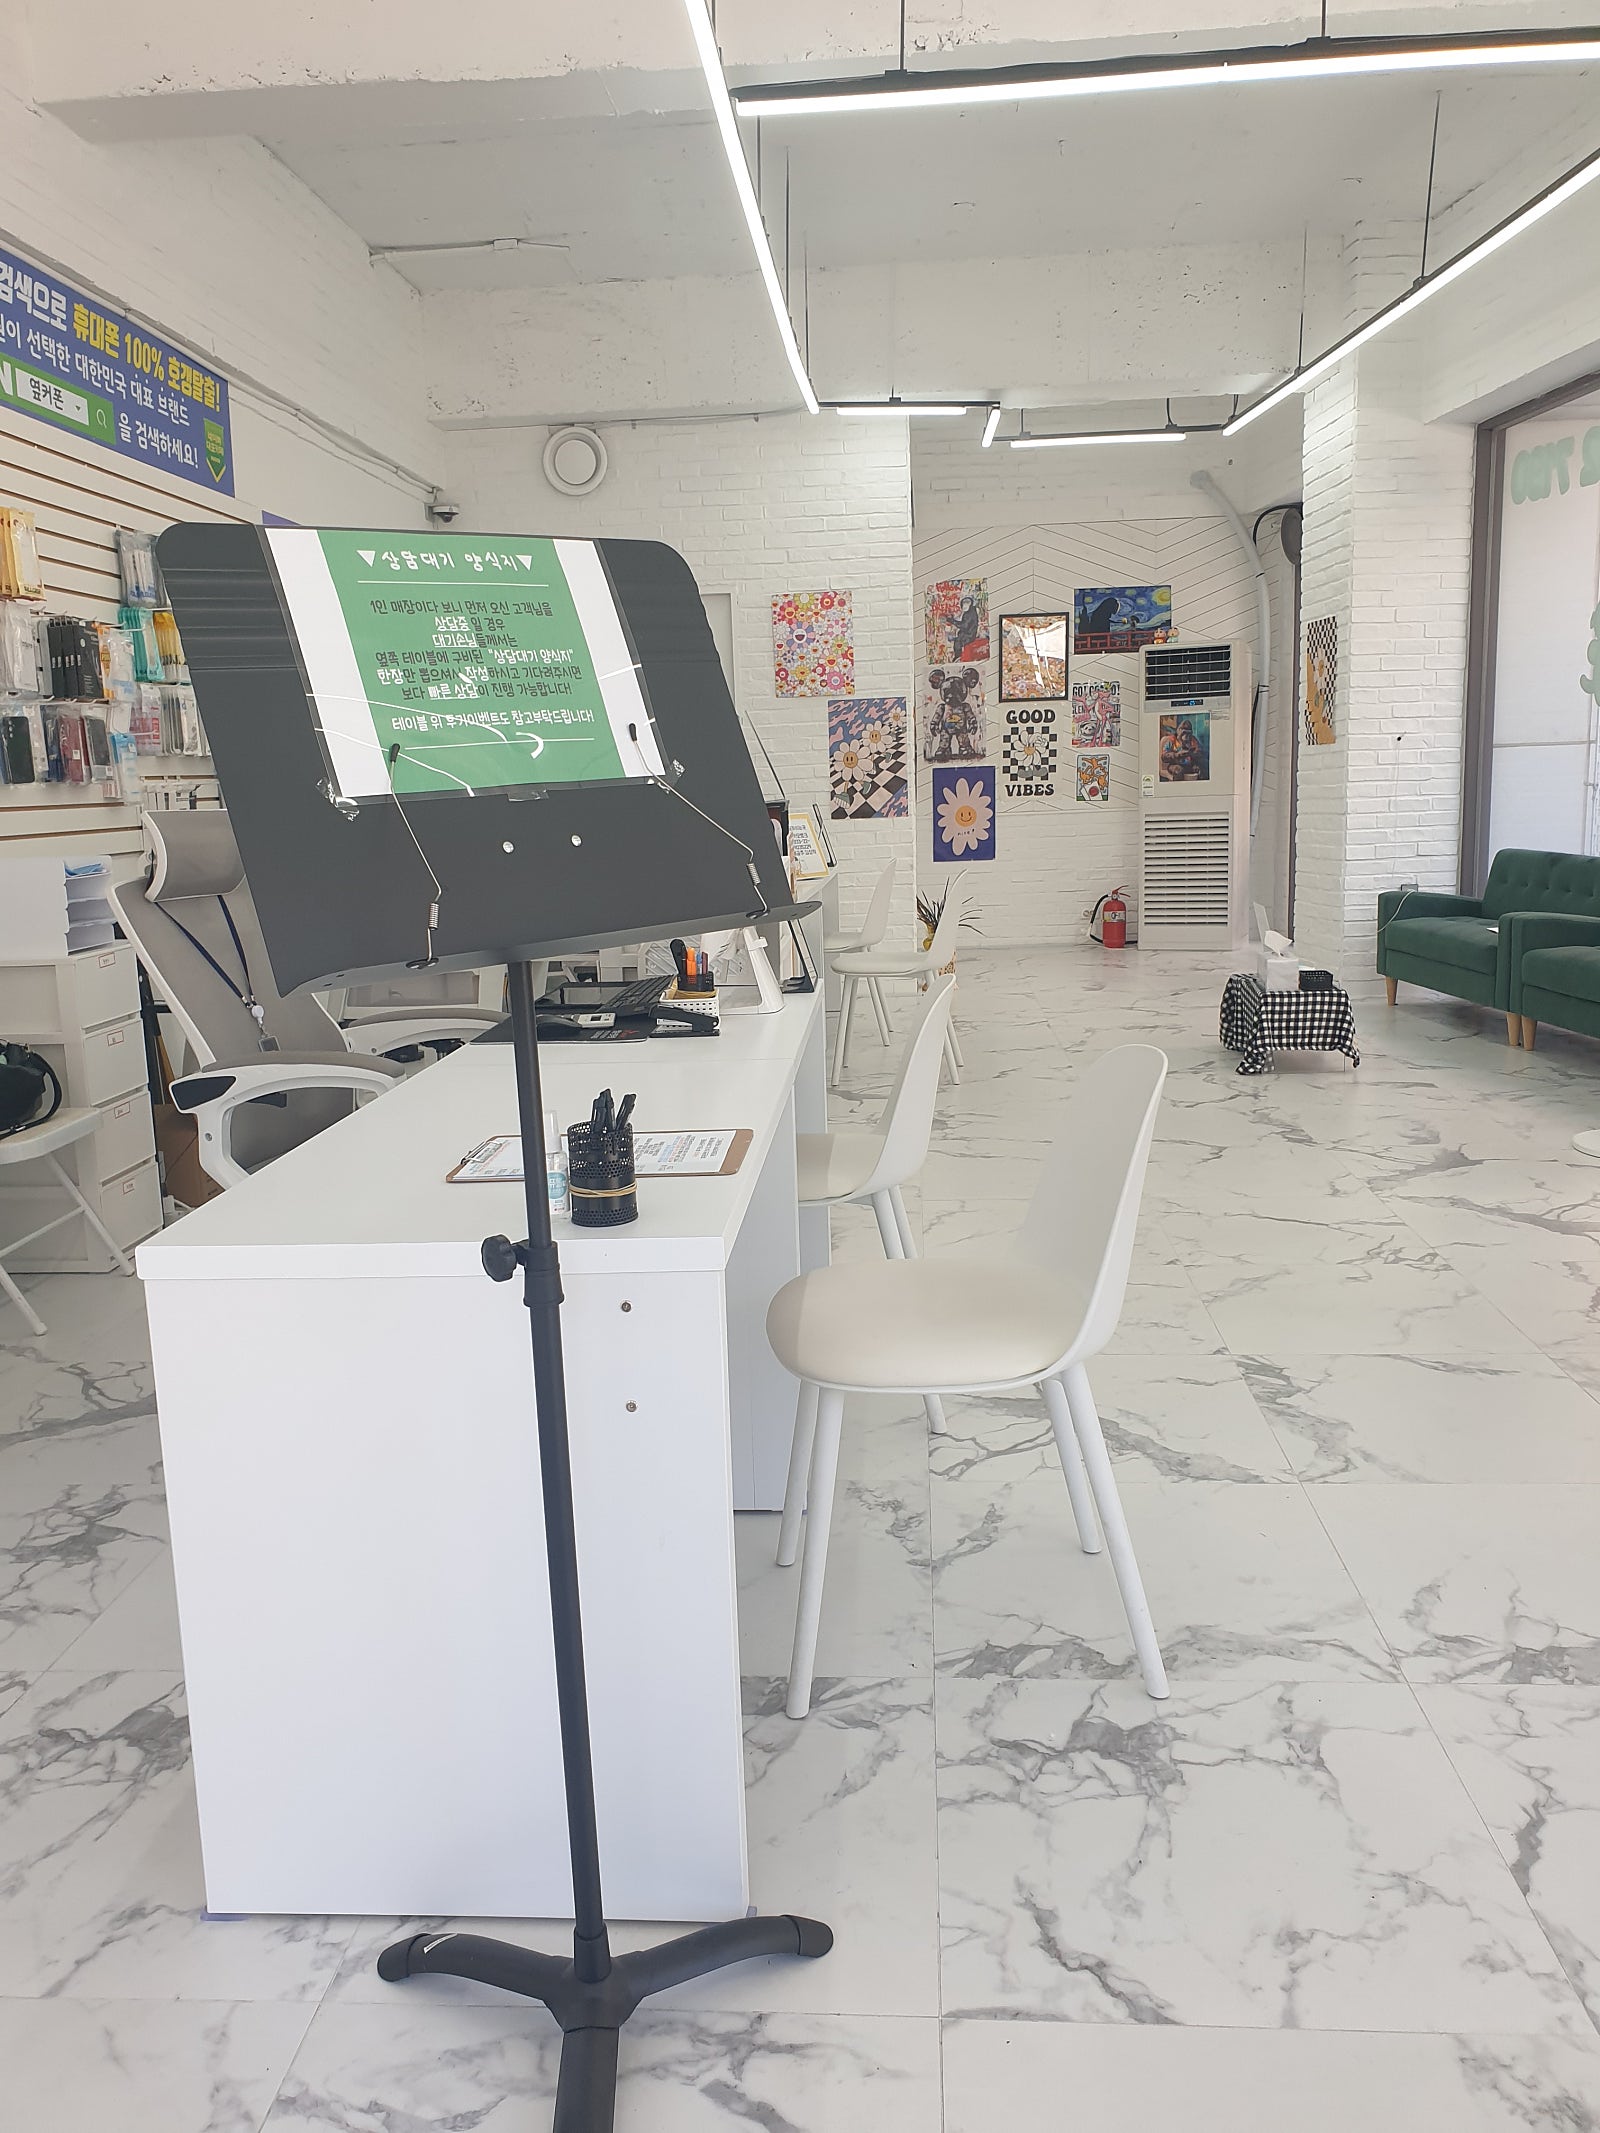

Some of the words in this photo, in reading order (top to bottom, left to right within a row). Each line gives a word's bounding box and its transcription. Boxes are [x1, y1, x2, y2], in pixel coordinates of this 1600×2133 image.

[73, 303, 120, 358] 휴대폰
[124, 333, 165, 381] 100%
[168, 356, 220, 412] 호갱탈출!
[27, 329, 70, 373] 선택한
[75, 353, 127, 399] 대한민국
[131, 379, 154, 409] 대표
[158, 393, 190, 426] 브랜드
[30, 378, 64, 410] 옆커폰
[118, 412, 132, 443] 을
[135, 420, 199, 469] 검색하세요!
[381, 550, 455, 571] 상담대기
[464, 551, 518, 572] 양식지
[370, 600, 388, 615] 1인
[390, 600, 438, 615] 매장이다
[441, 601, 463, 614] 보니
[464, 600, 488, 615] 먼저
[489, 601, 511, 616] 오신
[512, 601, 553, 617] 고객님을
[434, 615, 470, 632] 상담중
[484, 616, 505, 632] 경우
[432, 633, 518, 648] 대기손님들께서는
[375, 651, 400, 667] 옆쪽
[402, 650, 449, 666] 테이블에
[452, 649, 484, 664] 구비된
[376, 668, 416, 685] 한장만
[464, 665, 520, 682] 작성하시고
[522, 665, 582, 680] 기다려주시면
[402, 686, 426, 700] 보다
[427, 683, 451, 700] 빠른
[454, 683, 489, 699] 상담이
[490, 682, 515, 698] 진행
[516, 682, 573, 698] 가능합니다!
[392, 714, 428, 732] 테이블
[430, 714, 443, 730] 위
[1006, 709, 1056, 724] GOOD
[1005, 784, 1055, 797] VIBES
